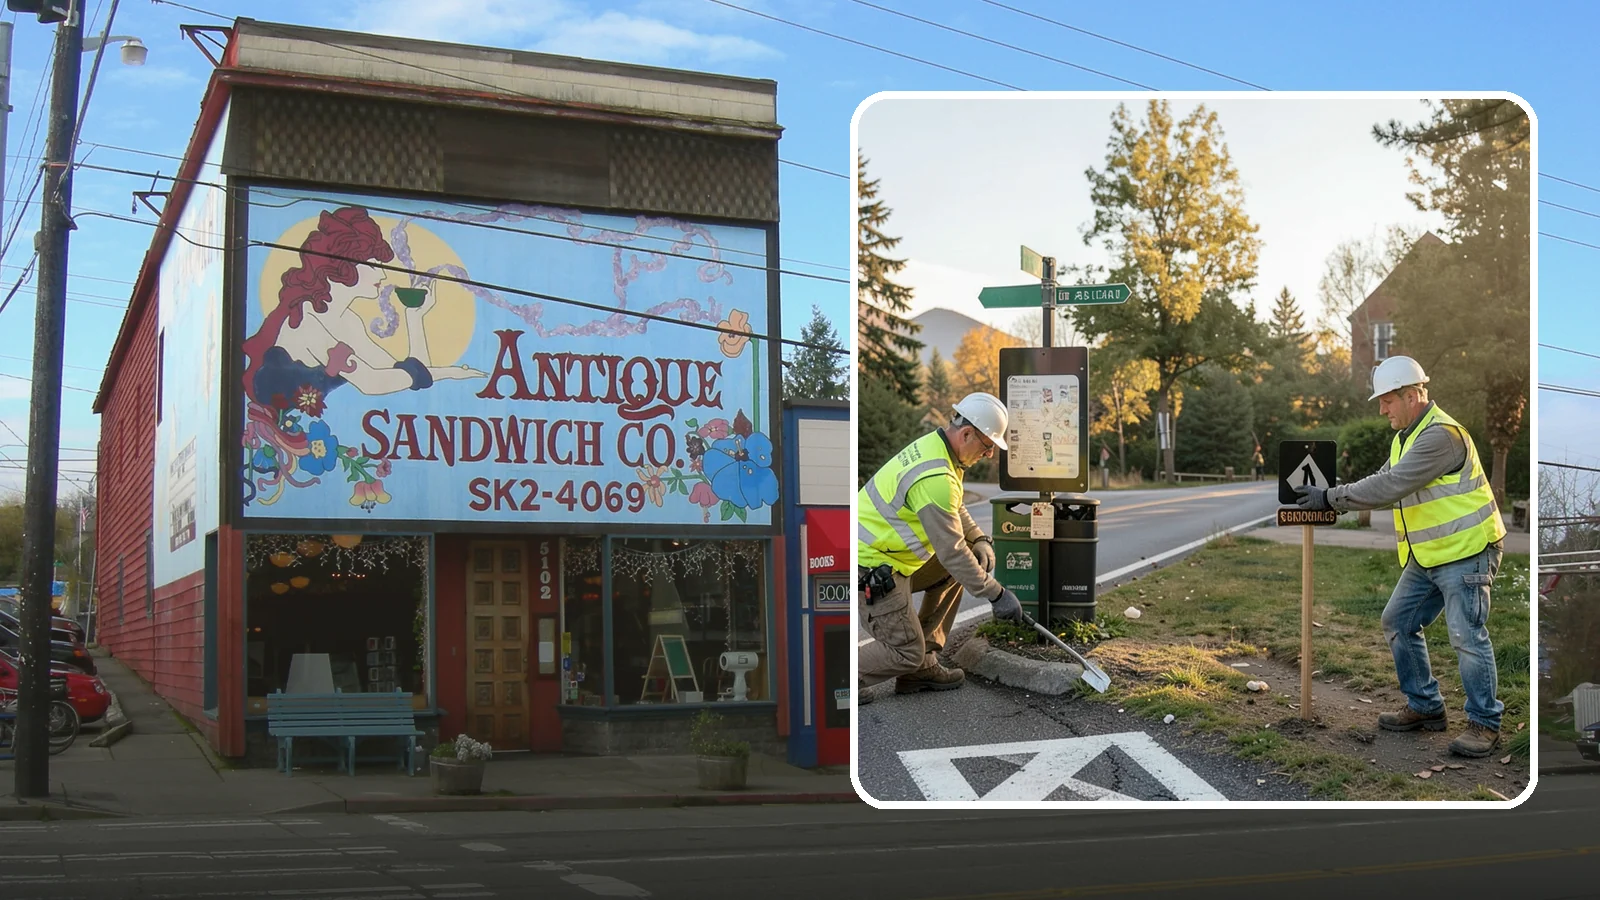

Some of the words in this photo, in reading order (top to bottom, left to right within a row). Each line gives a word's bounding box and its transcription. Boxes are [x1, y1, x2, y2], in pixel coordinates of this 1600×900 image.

[475, 329, 724, 421] ANTIQUE
[361, 409, 605, 467] SANDWICH
[617, 422, 684, 469] CO.
[468, 477, 645, 513] SK2-4069
[540, 542, 551, 599] 5102
[809, 555, 835, 568] BOOKS
